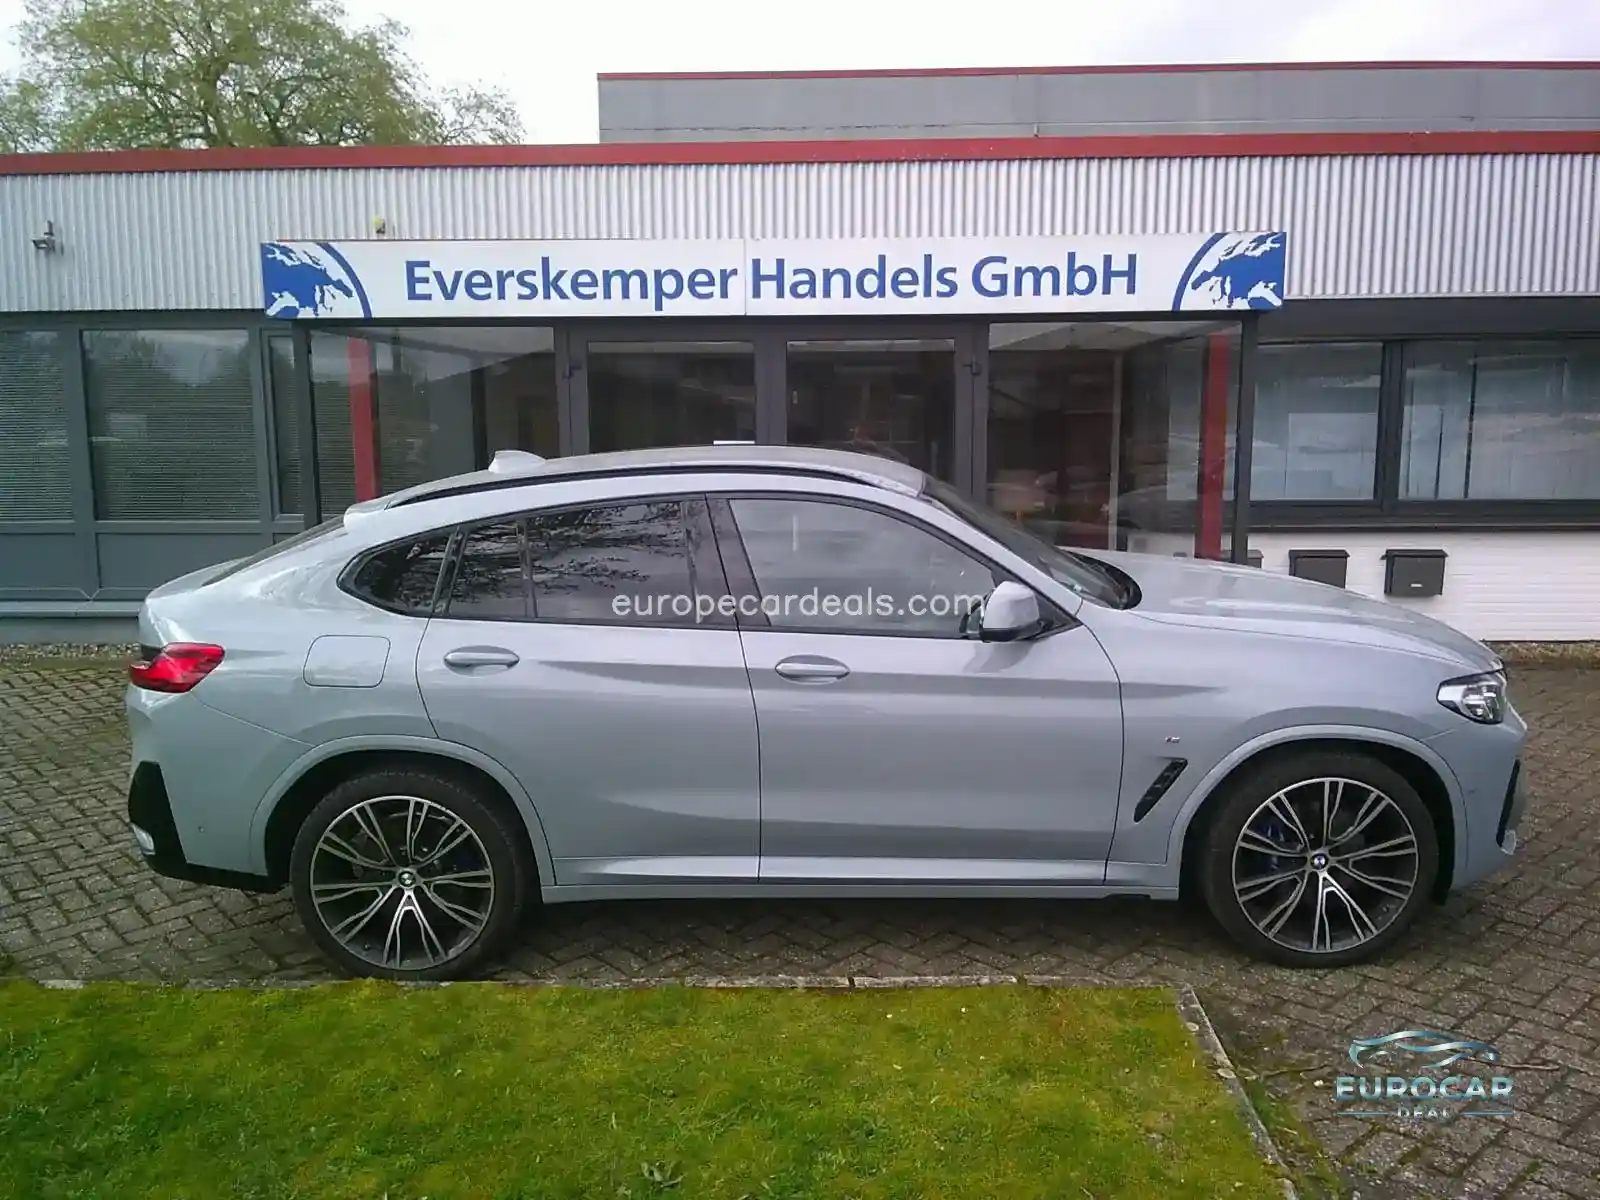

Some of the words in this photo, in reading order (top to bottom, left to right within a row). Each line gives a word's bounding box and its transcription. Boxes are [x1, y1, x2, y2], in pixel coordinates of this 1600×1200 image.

[405, 257, 739, 311] Everskemper
[751, 254, 959, 300] Handels
[971, 252, 1137, 297] GmbH
